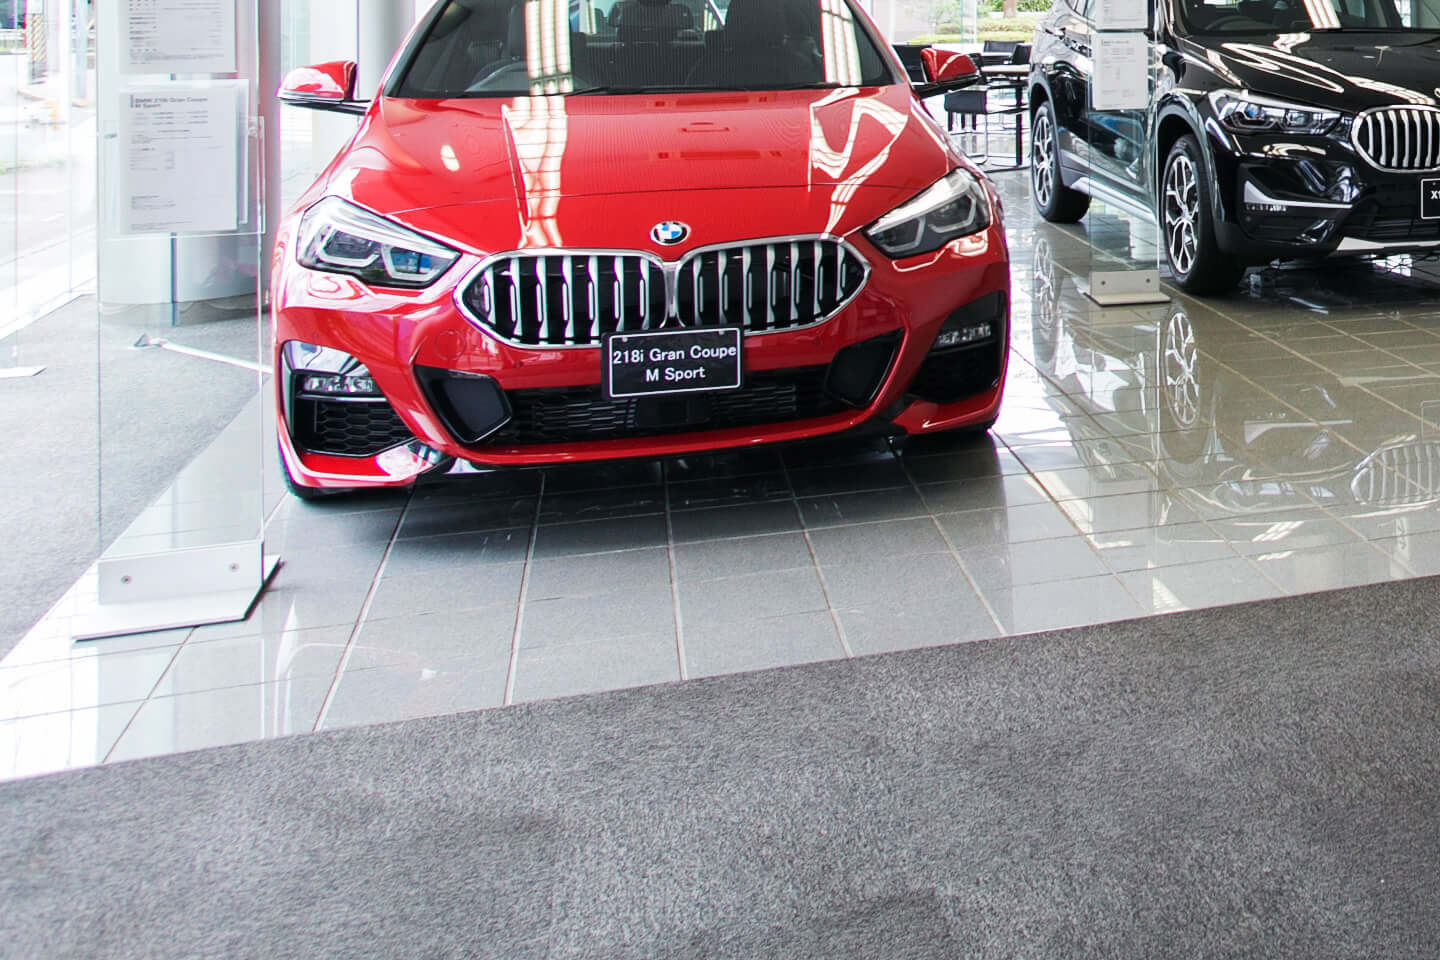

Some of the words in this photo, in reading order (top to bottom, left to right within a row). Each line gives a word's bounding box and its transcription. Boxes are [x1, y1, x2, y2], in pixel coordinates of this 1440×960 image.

[612, 349, 644, 364] 218i
[649, 348, 685, 361] Gran
[690, 345, 737, 359] Coupe
[646, 368, 660, 382] M
[664, 366, 706, 381] Sport
